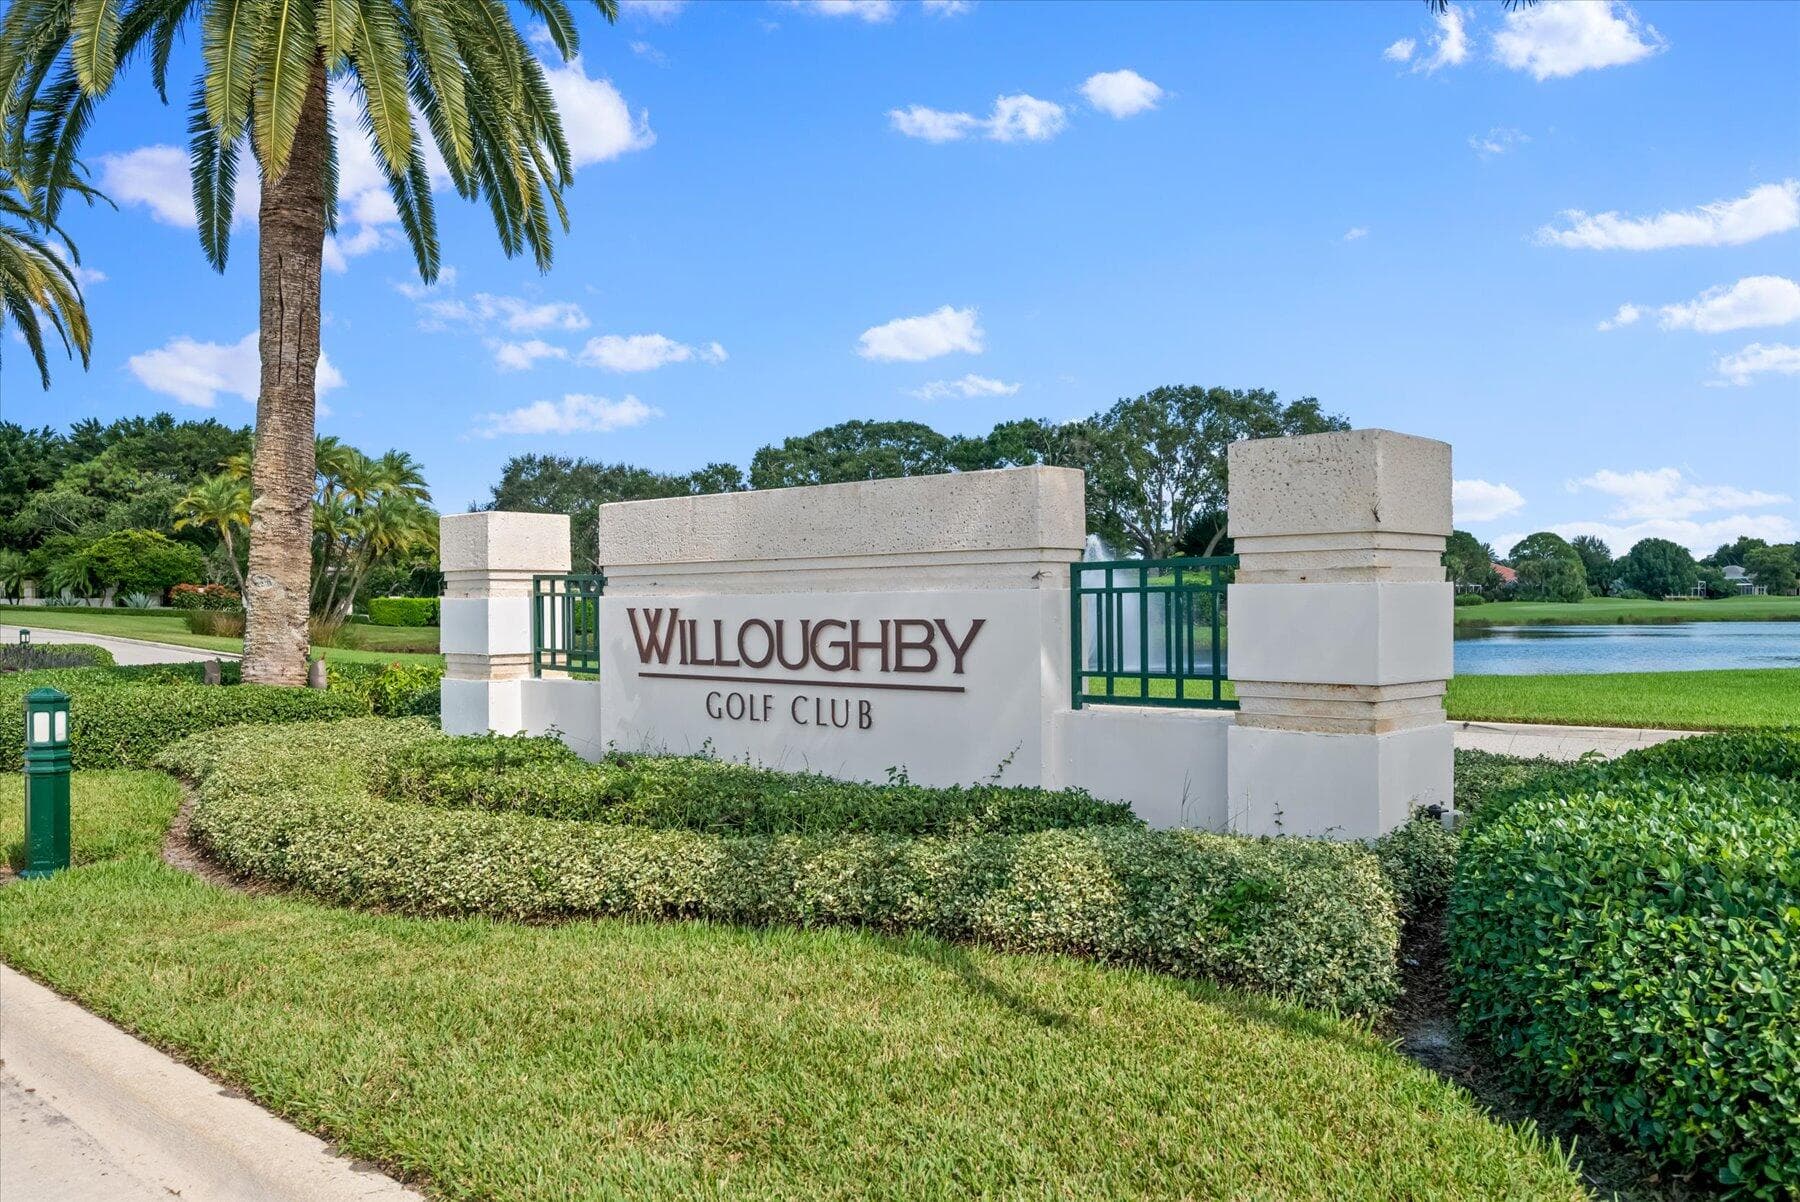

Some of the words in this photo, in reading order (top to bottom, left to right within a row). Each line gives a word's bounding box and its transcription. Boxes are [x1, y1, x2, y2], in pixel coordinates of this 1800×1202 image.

[626, 607, 987, 675] WILLOUGHBY
[705, 690, 774, 723] GOLF
[790, 694, 874, 731] CLUB
